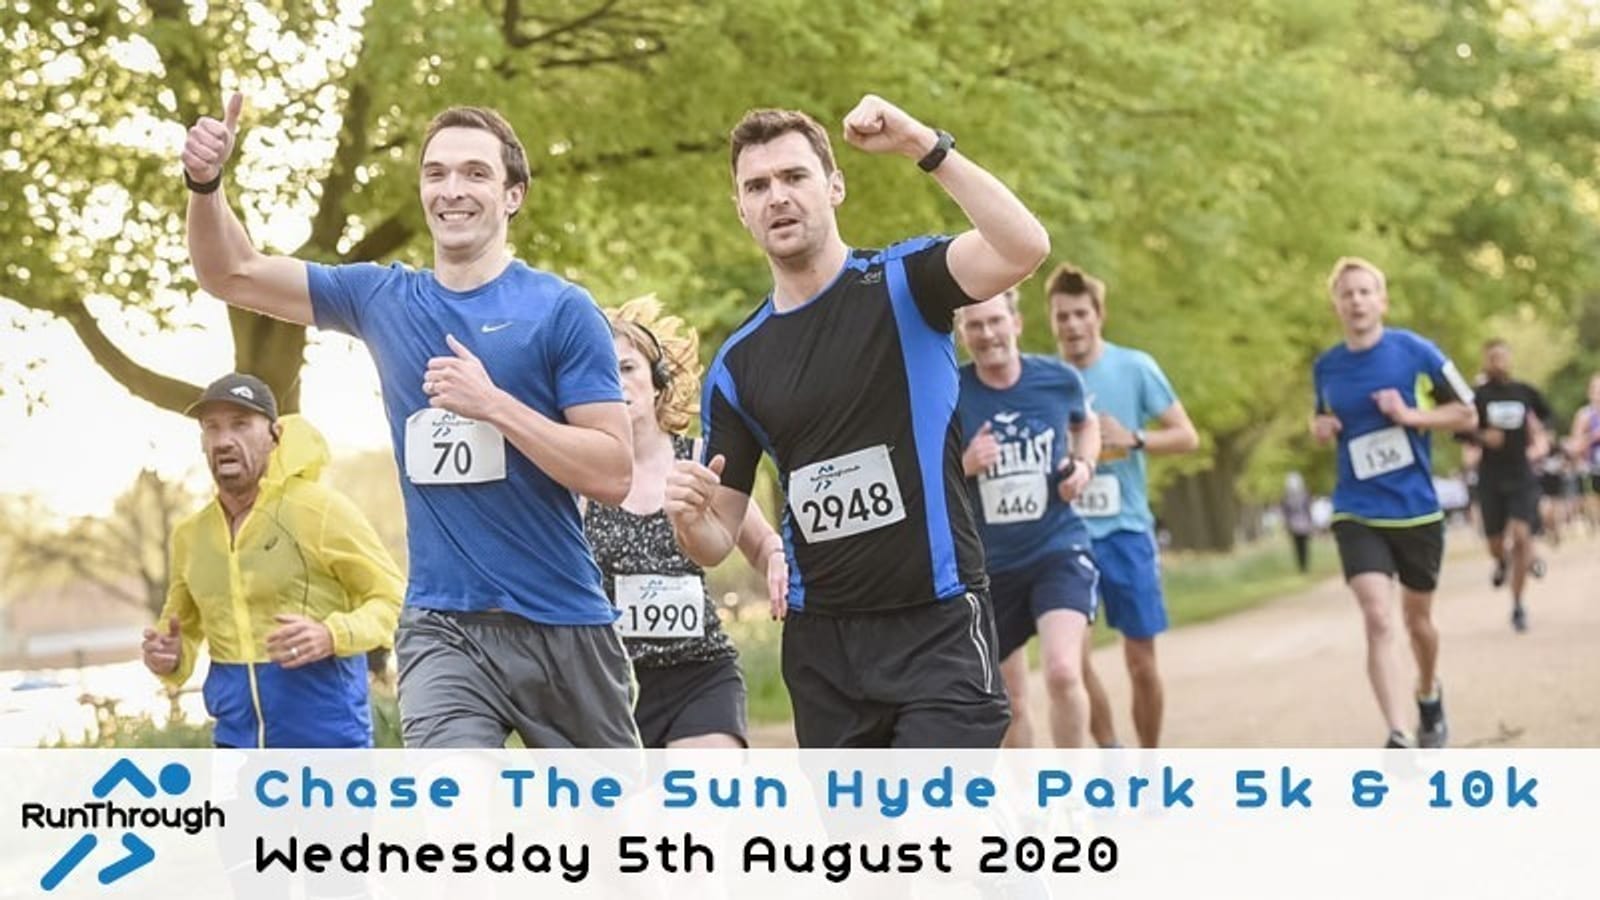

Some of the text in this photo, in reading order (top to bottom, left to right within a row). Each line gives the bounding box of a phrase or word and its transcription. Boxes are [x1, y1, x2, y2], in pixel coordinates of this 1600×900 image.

[433, 440, 472, 476] 70
[802, 482, 893, 533] 2948
[996, 494, 1038, 515] 446
[628, 604, 698, 632] 1990
